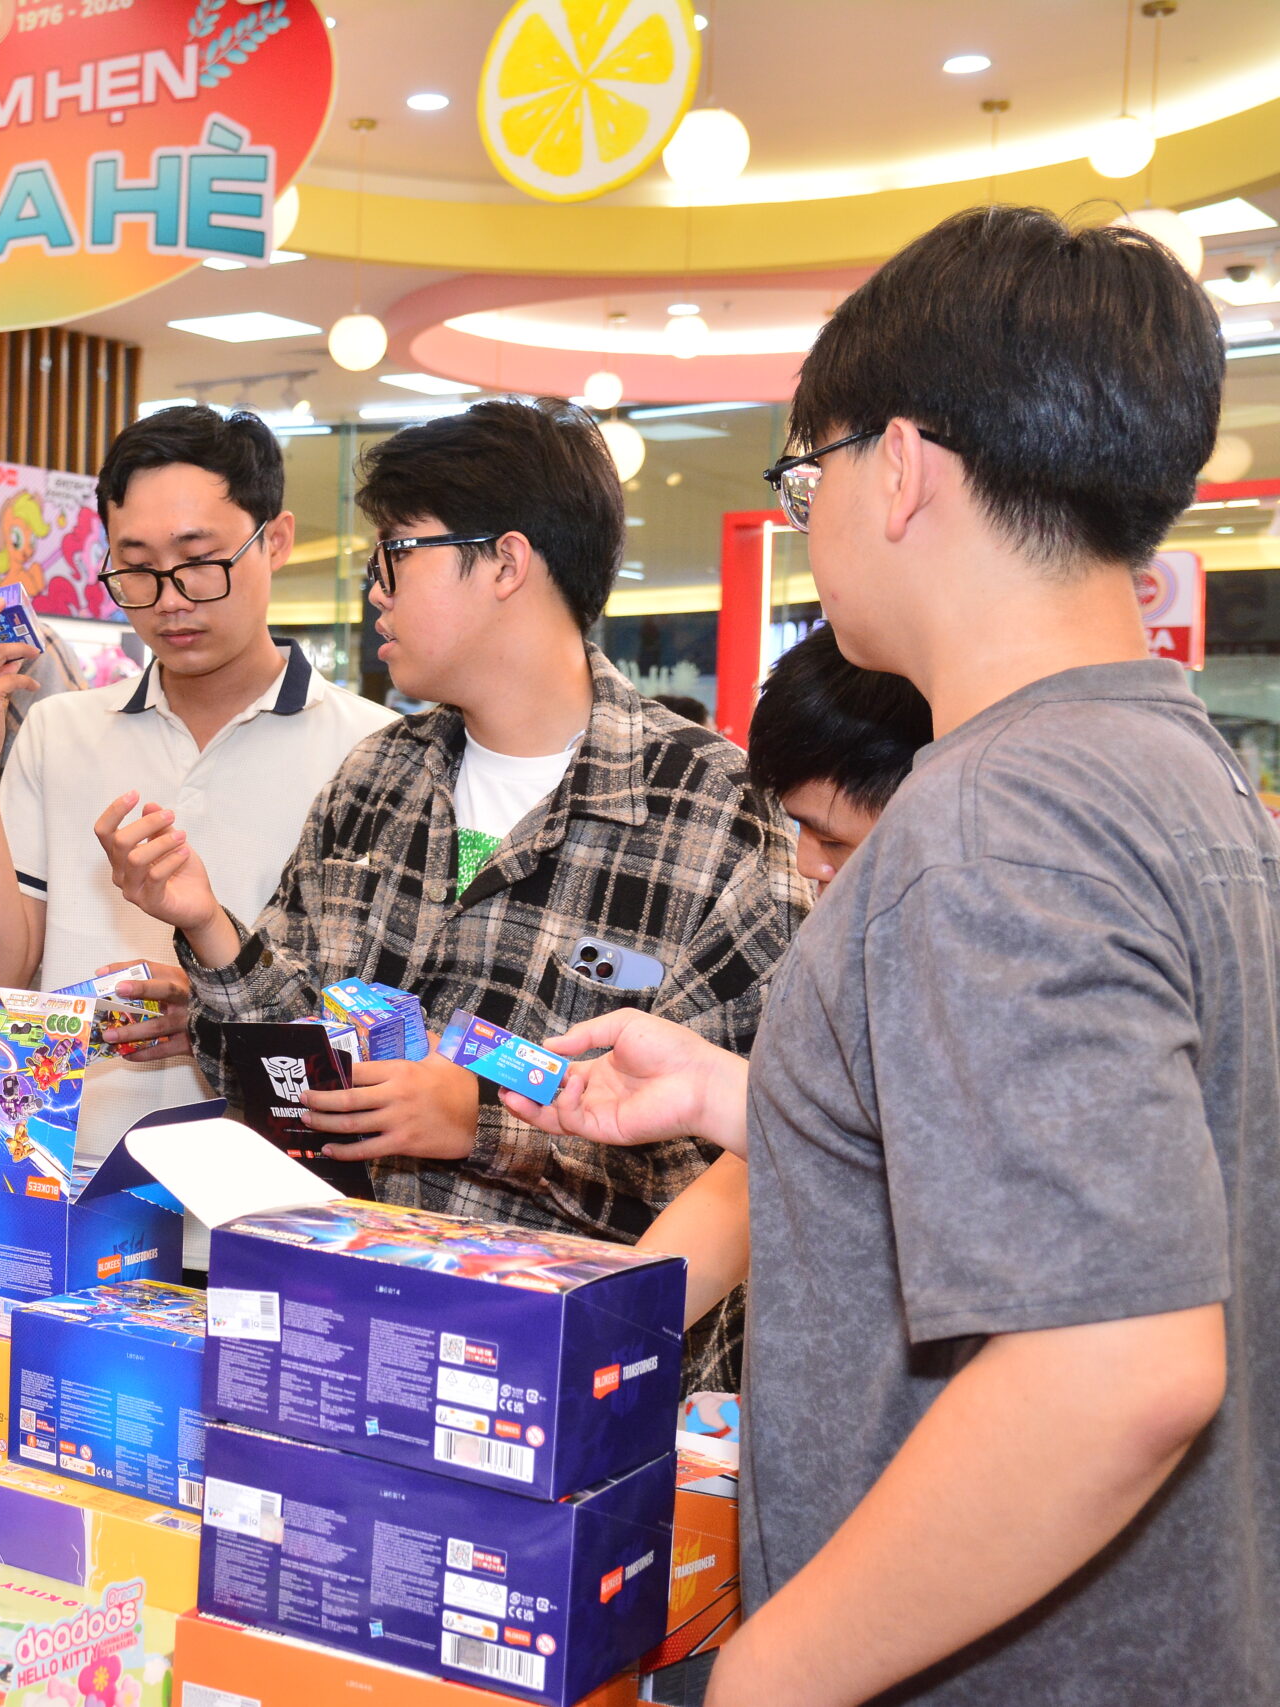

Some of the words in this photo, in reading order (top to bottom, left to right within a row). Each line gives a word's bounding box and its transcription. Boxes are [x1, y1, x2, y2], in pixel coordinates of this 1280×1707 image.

[17, 4, 64, 32] 1976
[44, 43, 199, 124] HẸN
[88, 116, 273, 262] HÈ
[28, 1181, 60, 1195] BLOKEES
[98, 1259, 120, 1272] BLOKEES
[674, 1554, 716, 1580] TRANSFORMERS
[16, 1601, 137, 1665] daadoos
[17, 1659, 59, 1689] HELLO
[62, 1643, 100, 1672] KITTY
